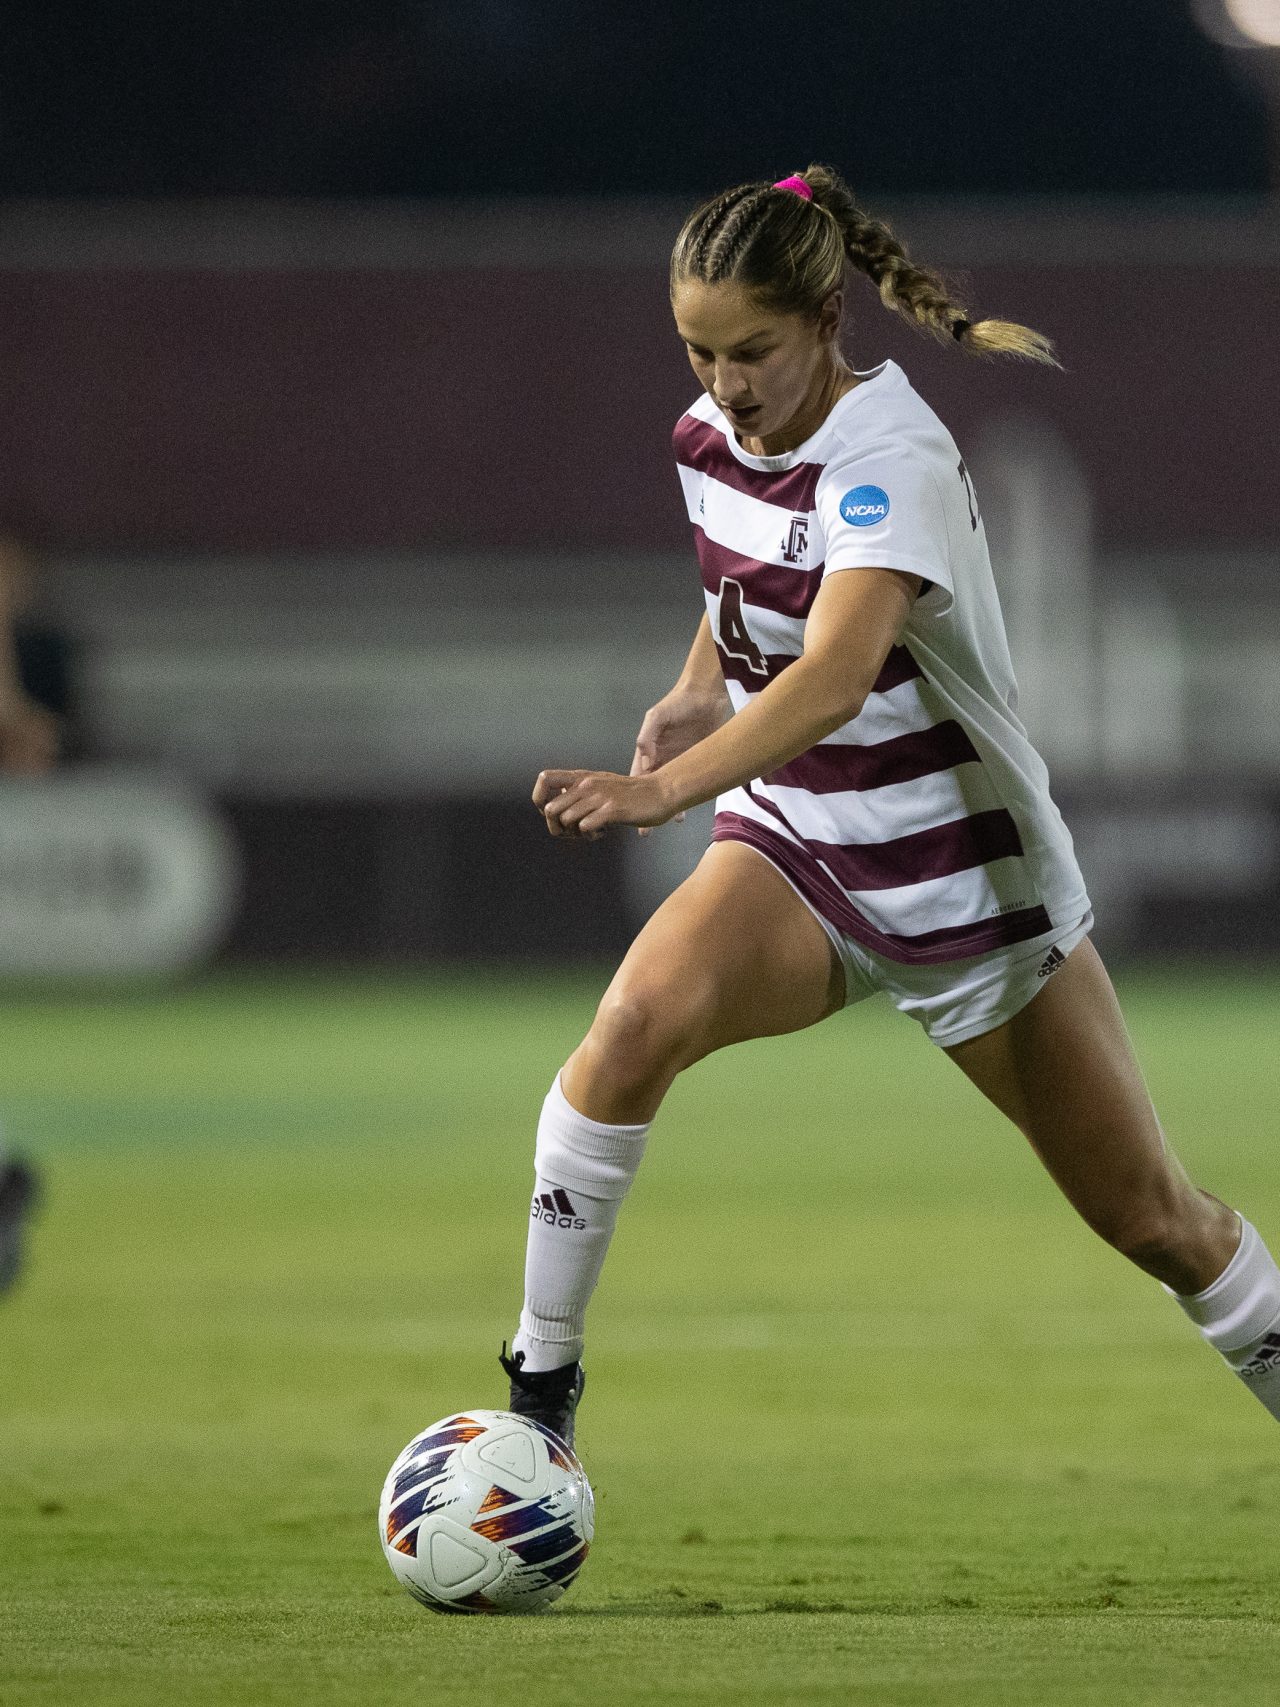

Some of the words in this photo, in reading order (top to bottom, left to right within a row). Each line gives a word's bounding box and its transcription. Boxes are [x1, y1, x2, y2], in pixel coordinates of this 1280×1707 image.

[845, 504, 885, 517] NCAA
[717, 575, 768, 676] 4
[530, 1204, 587, 1231] didas
